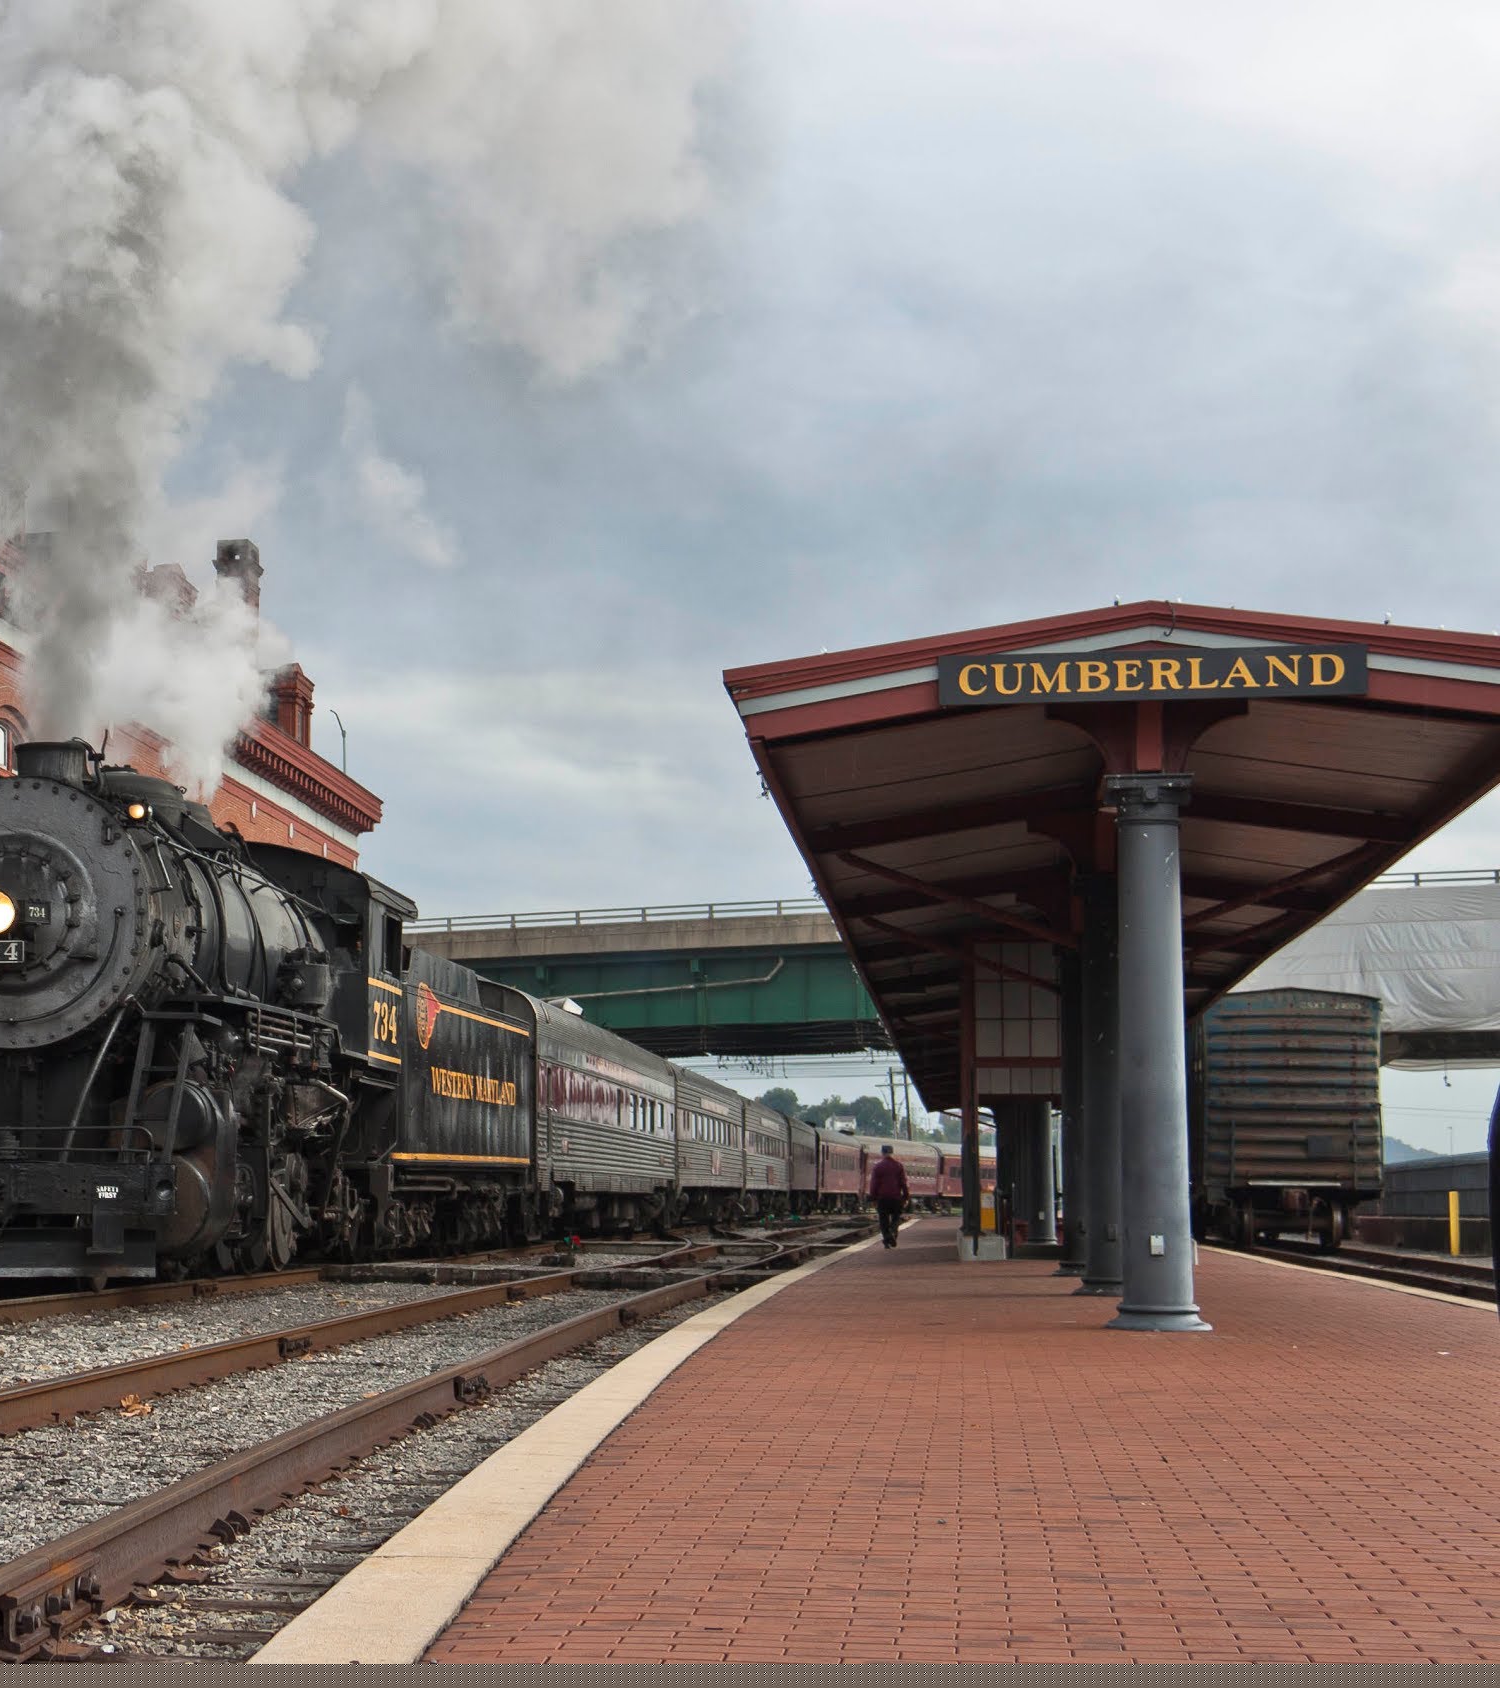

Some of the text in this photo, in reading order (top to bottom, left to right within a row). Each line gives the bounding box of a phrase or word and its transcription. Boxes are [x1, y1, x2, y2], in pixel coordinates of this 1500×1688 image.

[957, 653, 1346, 696] CUMBERLAND
[28, 906, 46, 918] 734
[373, 1000, 398, 1045] 734
[430, 1066, 516, 1106] WESTERN MARYLAND
